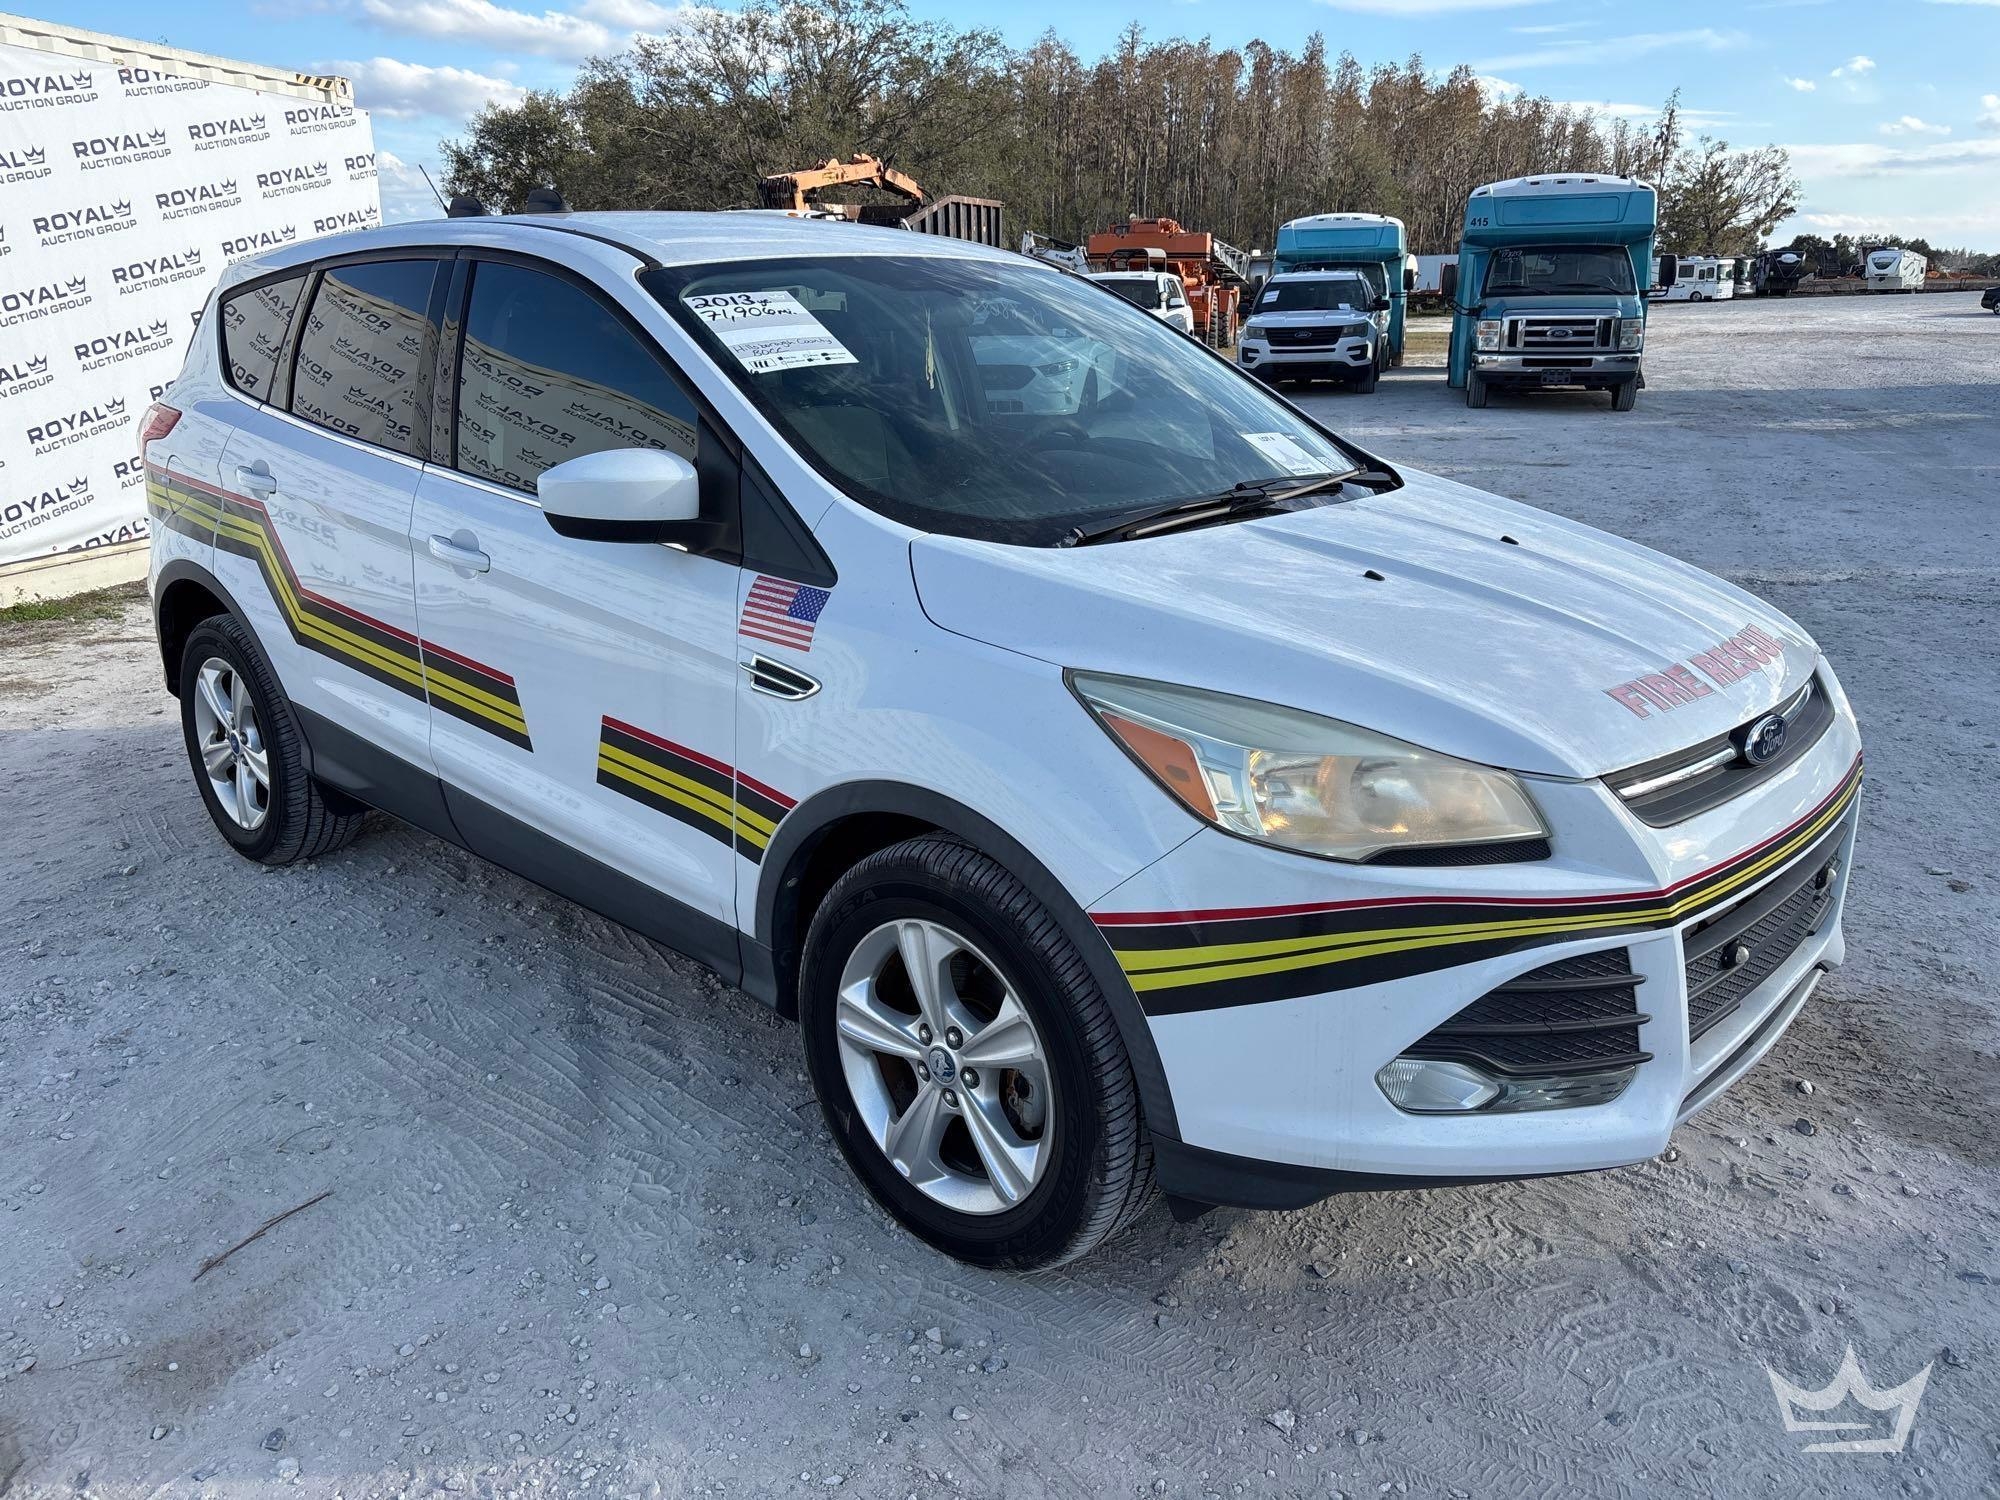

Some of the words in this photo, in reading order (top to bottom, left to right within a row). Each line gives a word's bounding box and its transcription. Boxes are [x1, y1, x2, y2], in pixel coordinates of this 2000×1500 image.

[56, 92, 98, 106] GROUP
[125, 83, 173, 97] AUCTION
[174, 80, 210, 93] GROUP
[285, 106, 340, 125] ROYAL
[290, 123, 328, 135] AUCTION
[328, 119, 357, 131] GROUP
[188, 118, 251, 140] ROYAL
[72, 133, 149, 158] ROYAL
[194, 138, 237, 152] AUCTION
[239, 132, 270, 145] GROUP
[80, 154, 132, 171] AUCTION
[133, 148, 172, 162] GROUP
[6, 167, 52, 183] GROUP
[257, 166, 314, 188] ROYAL
[155, 183, 222, 209] ROYAL
[262, 185, 301, 199] AUCTION
[302, 178, 331, 191] GROUP
[33, 205, 114, 234] ROYAL
[162, 204, 207, 221] AUCTION
[208, 197, 242, 211] GROUP
[41, 228, 94, 247] AUCTION
[96, 219, 137, 235] GROUP
[314, 210, 366, 233] ROYAL
[1470, 217, 1489, 227] 415
[222, 231, 282, 256] ROYAL
[112, 254, 185, 284] ROYAL
[119, 277, 168, 296] AUCTION
[170, 266, 206, 282] GROUP
[0, 284, 67, 313] OYAL
[50, 296, 92, 314] GROUP
[692, 294, 756, 309] 2013
[700, 307, 775, 322] 71,906
[74, 327, 151, 361] ROYAL
[81, 350, 133, 373] AUCTION
[134, 337, 173, 356] GROUP
[9, 374, 54, 396] GROUP
[26, 406, 107, 444] ROYAL
[35, 432, 88, 456] AUCTION
[91, 415, 131, 436] GROUP
[0, 487, 70, 526] OYAL
[52, 494, 95, 518] GROUP
[68, 521, 146, 551] OYAL
[1602, 663, 1716, 720] FIRE
[1762, 723, 1784, 756] Ford
